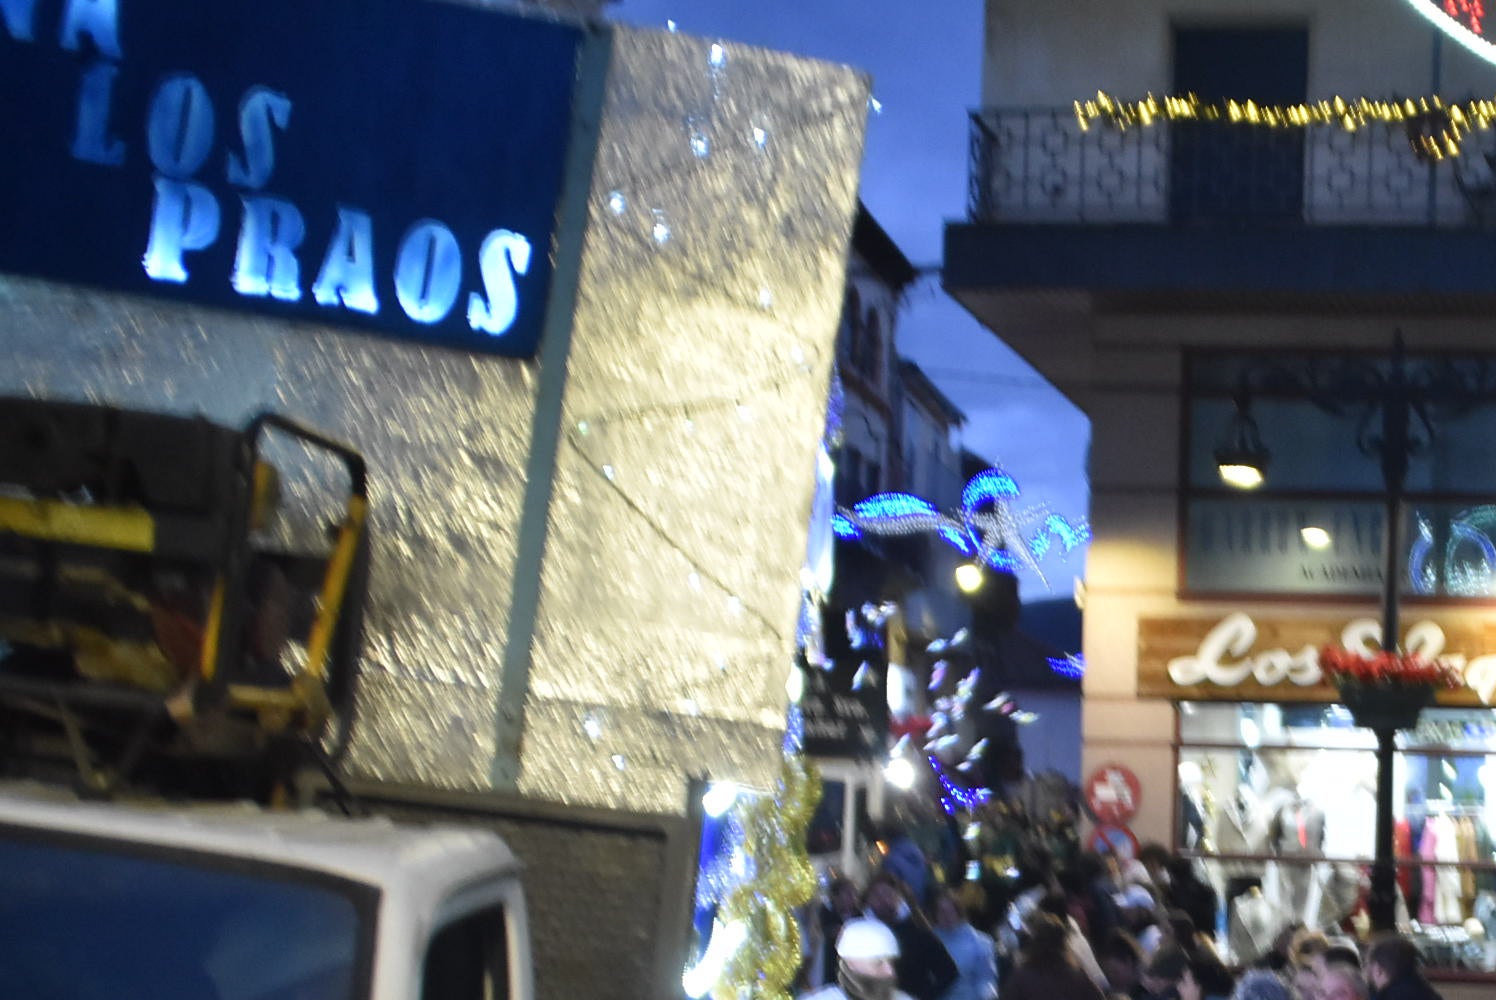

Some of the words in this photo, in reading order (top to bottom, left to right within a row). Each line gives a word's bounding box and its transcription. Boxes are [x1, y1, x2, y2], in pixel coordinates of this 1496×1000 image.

[70, 62, 292, 189] LOS
[142, 178, 532, 336] PRAOS
[1168, 612, 1323, 687] Los
